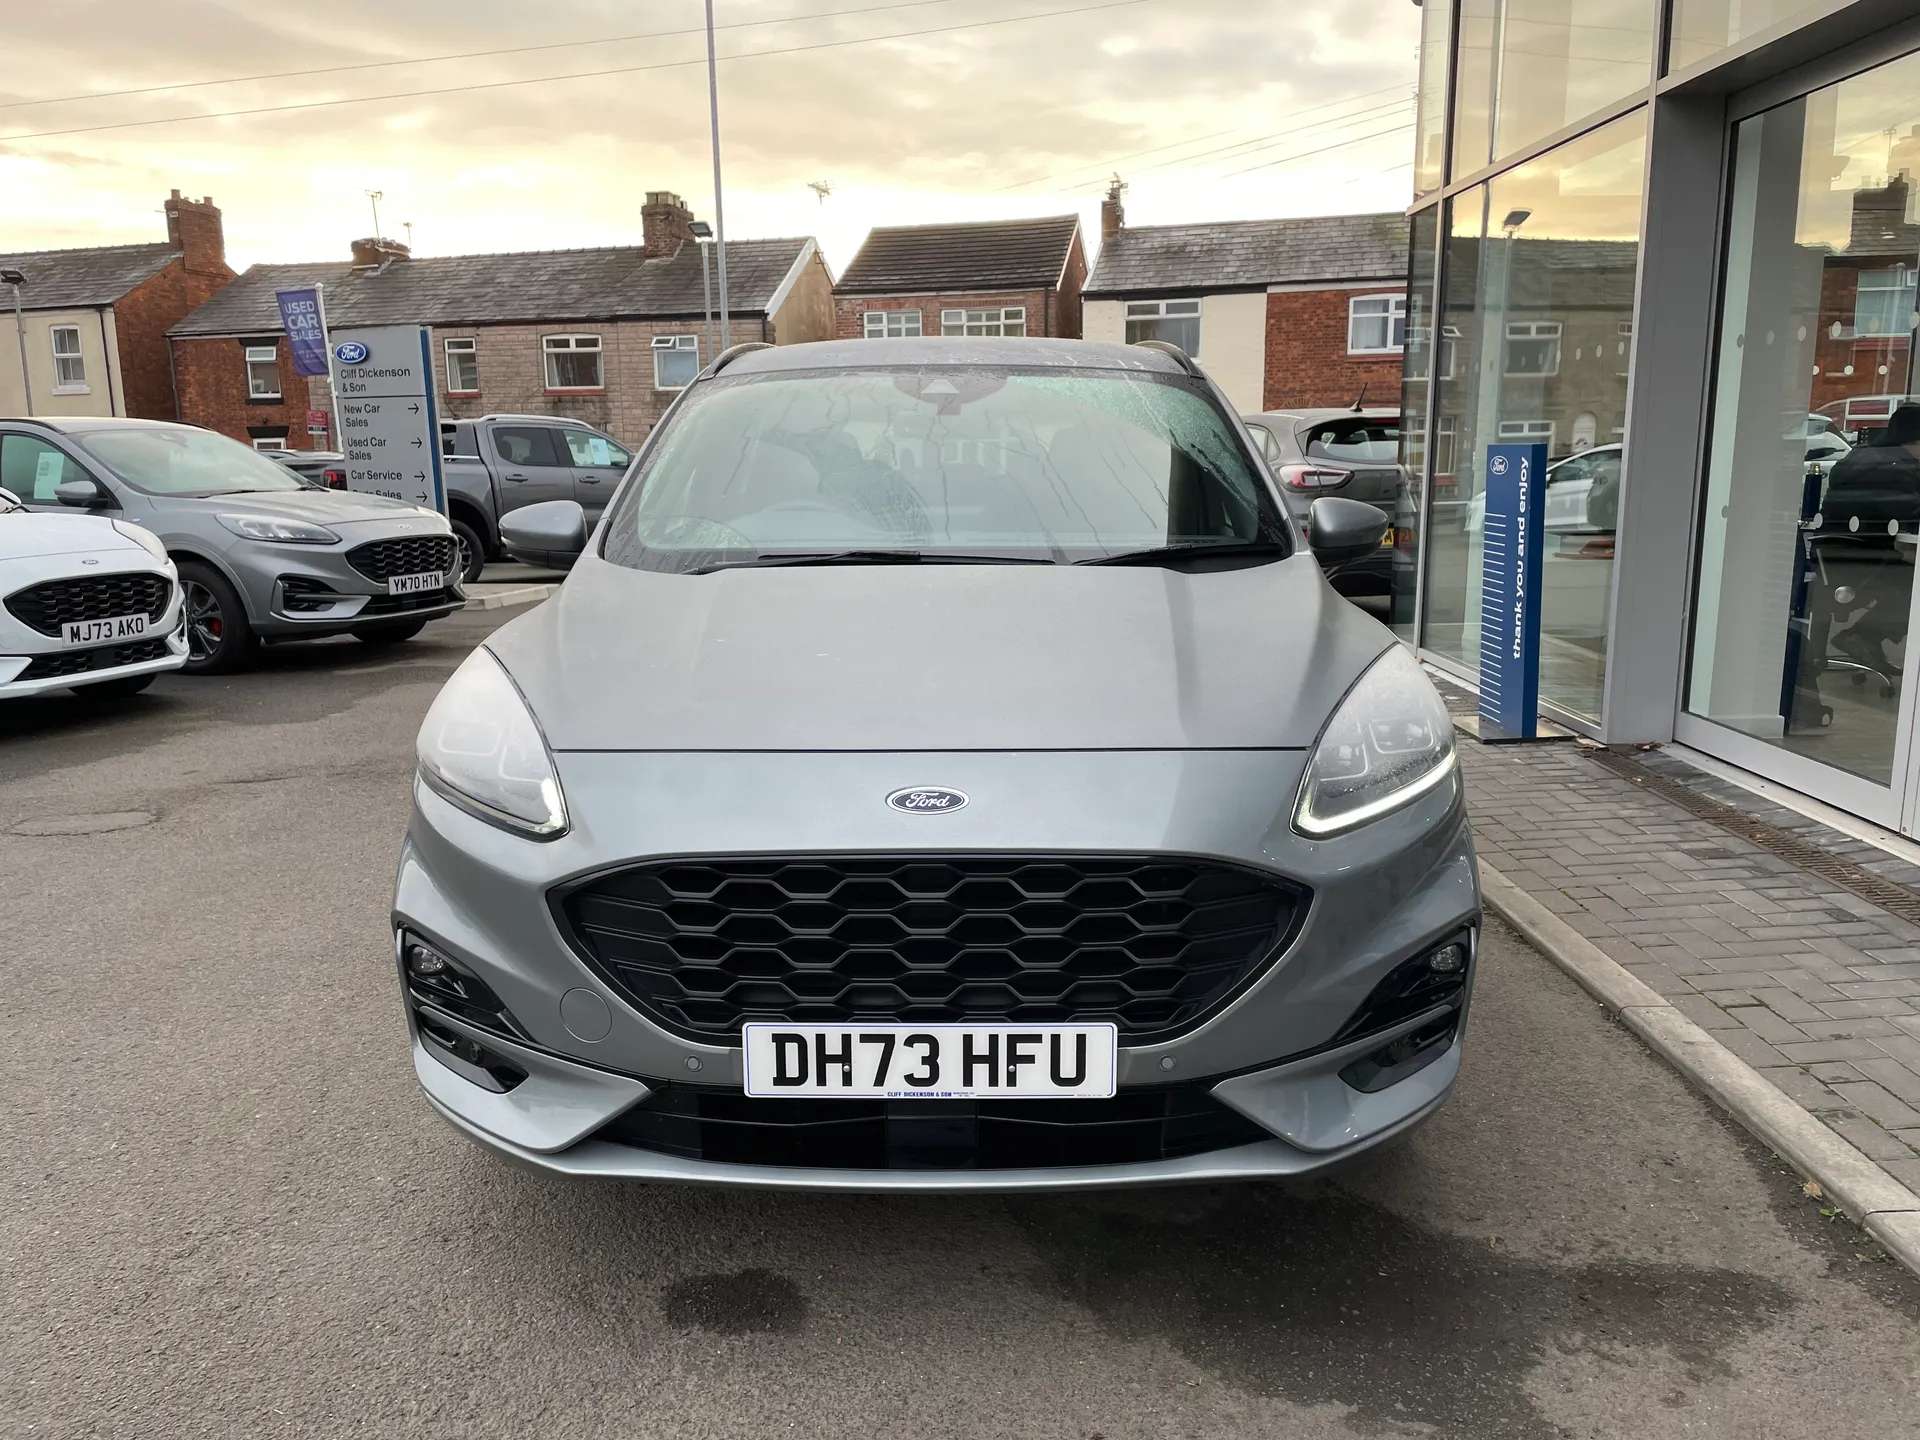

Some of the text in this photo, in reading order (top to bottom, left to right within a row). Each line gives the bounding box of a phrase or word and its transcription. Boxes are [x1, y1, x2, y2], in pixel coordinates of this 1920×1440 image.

[284, 300, 315, 314] USED
[287, 314, 320, 329] CAR
[290, 329, 322, 342] SALES
[340, 367, 411, 380] Cliff Dickenson
[342, 381, 367, 393] & Son
[344, 403, 380, 414] New Car
[345, 417, 369, 428] Sales
[347, 436, 387, 447] Used Car
[348, 450, 372, 460] Sales
[351, 470, 403, 481] Car Service
[1513, 456, 1529, 659] thank you and enjoy
[393, 573, 440, 592] YM70 HTN
[69, 618, 144, 643] MJ73 AKO
[771, 1033, 1087, 1088] DH73 HFU
